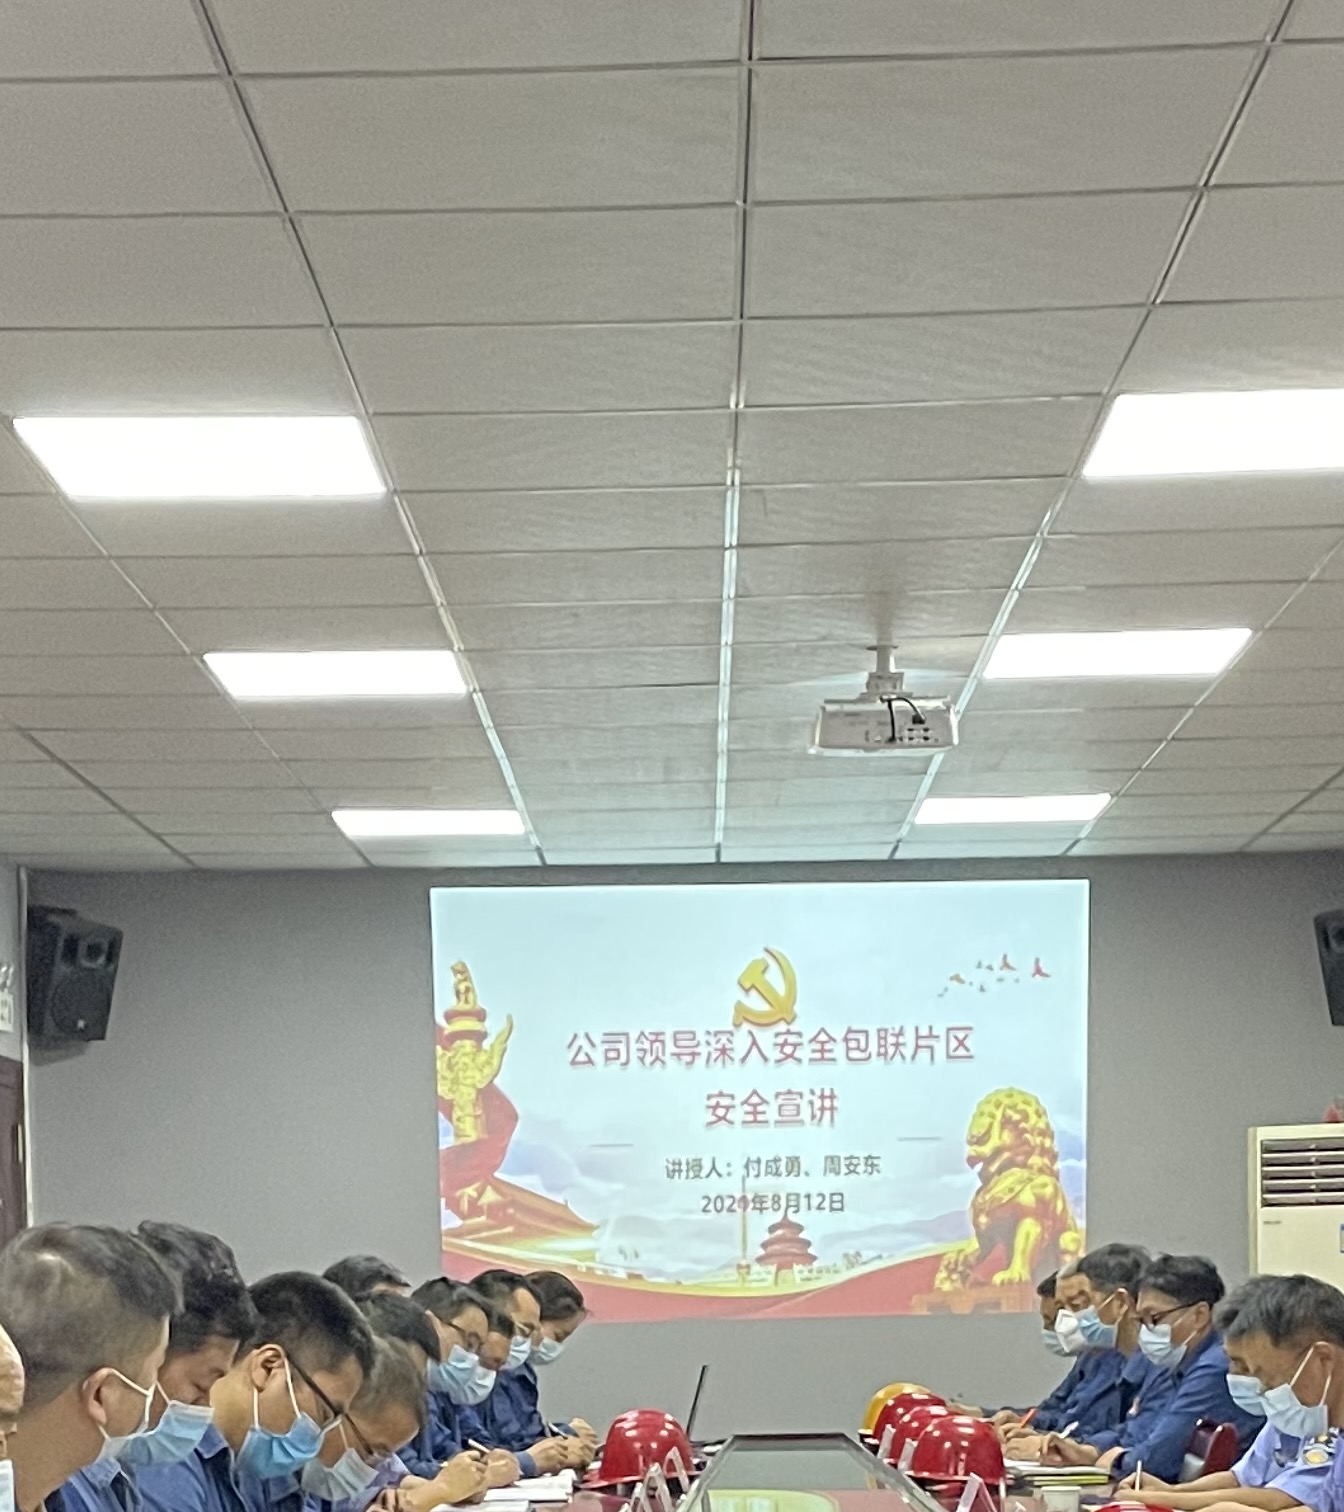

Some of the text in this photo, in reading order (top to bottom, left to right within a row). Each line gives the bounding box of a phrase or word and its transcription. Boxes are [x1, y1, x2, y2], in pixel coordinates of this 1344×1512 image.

[566, 1025, 976, 1068] 公司领导深入安全包联片区
[705, 1087, 839, 1128] 安全宣讲
